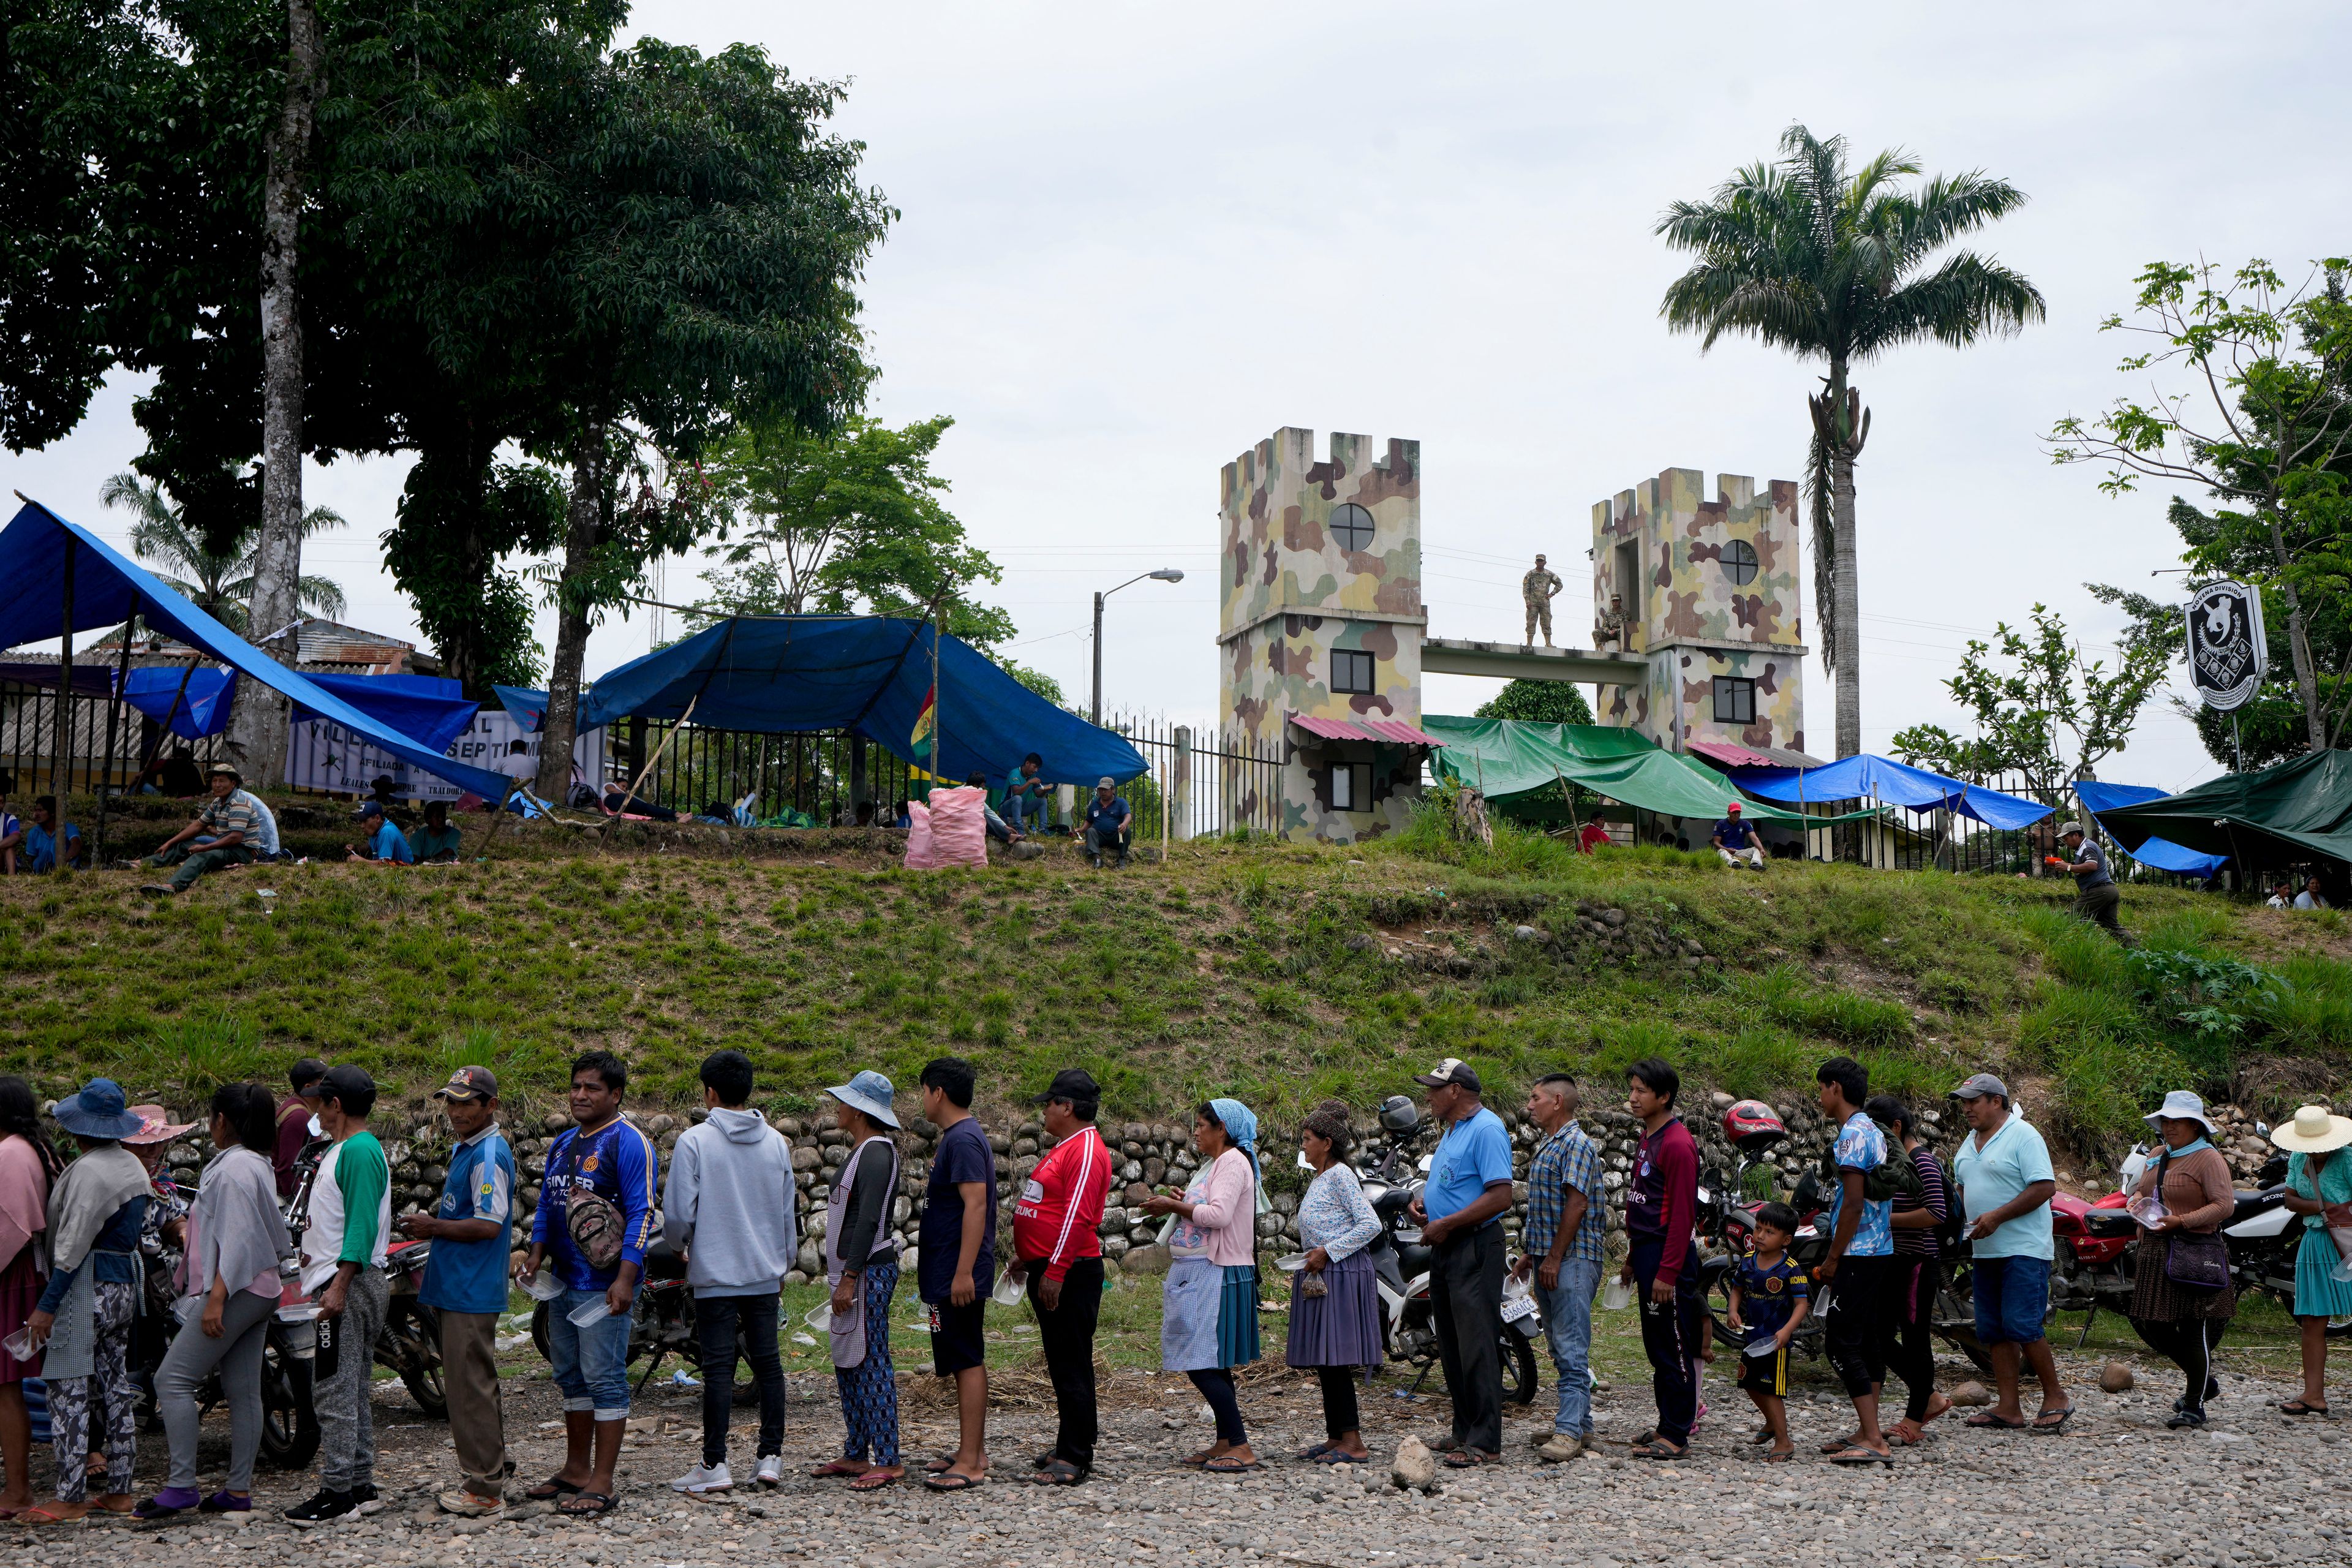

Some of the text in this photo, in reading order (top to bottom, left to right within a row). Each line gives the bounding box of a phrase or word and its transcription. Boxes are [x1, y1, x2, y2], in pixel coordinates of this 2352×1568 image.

[2192, 586, 2242, 609] NOVENA DIVISION
[360, 758, 404, 772] AFILIADA
[340, 777, 369, 789] LEALES
[2261, 1193, 2285, 1202] HON
[1014, 1205, 1038, 1219] ZUKI
[1728, 1226, 1740, 1234] BOXER
[598, 1244, 611, 1255] FILA
[1749, 1291, 1785, 1300] TeamViewer
[1502, 1299, 1534, 1321] 5366ACC
